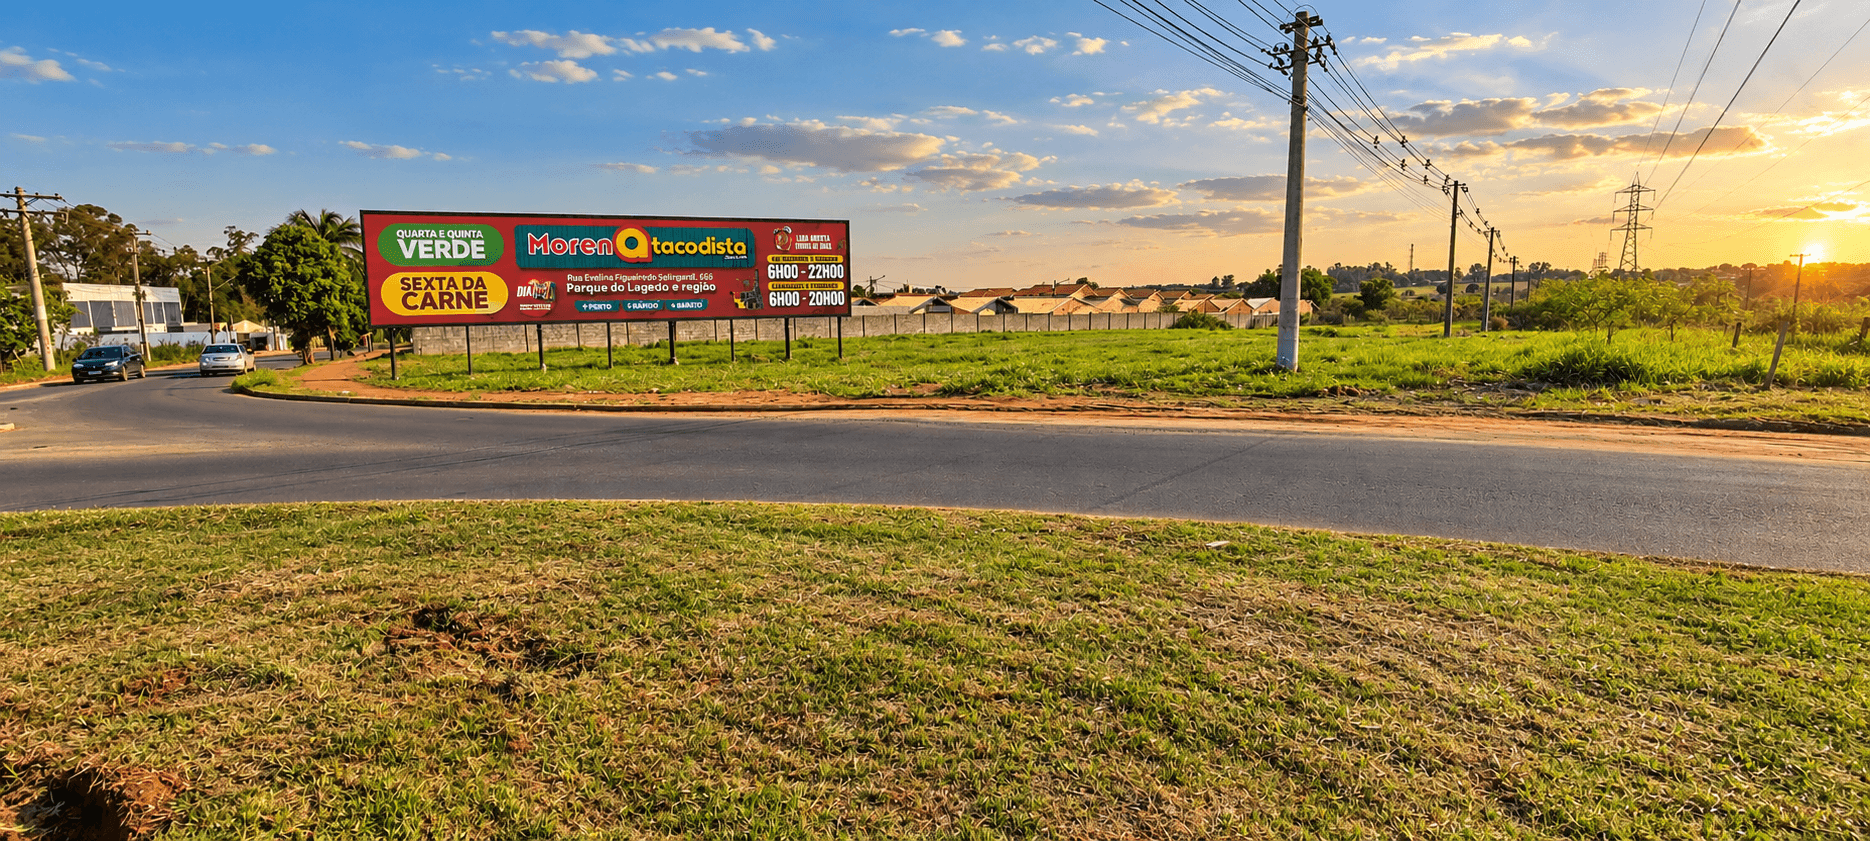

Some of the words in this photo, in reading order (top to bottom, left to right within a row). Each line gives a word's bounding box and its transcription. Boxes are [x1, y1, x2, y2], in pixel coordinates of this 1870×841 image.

[396, 229, 438, 239] QUARTA
[438, 229, 446, 239] E
[446, 229, 484, 239] QUINTA
[397, 238, 487, 259] VERDE
[767, 264, 799, 280] 6H00
[807, 264, 845, 280] 22H00
[400, 276, 459, 291] SEXTA
[461, 276, 488, 290] DA
[566, 282, 609, 295] Parque
[610, 281, 626, 293] do
[627, 282, 670, 295] Lagedo
[671, 283, 680, 292] e
[681, 281, 717, 295] região
[401, 291, 490, 311] CARNE
[769, 291, 800, 307] 6H00
[808, 291, 845, 306] 20H00
